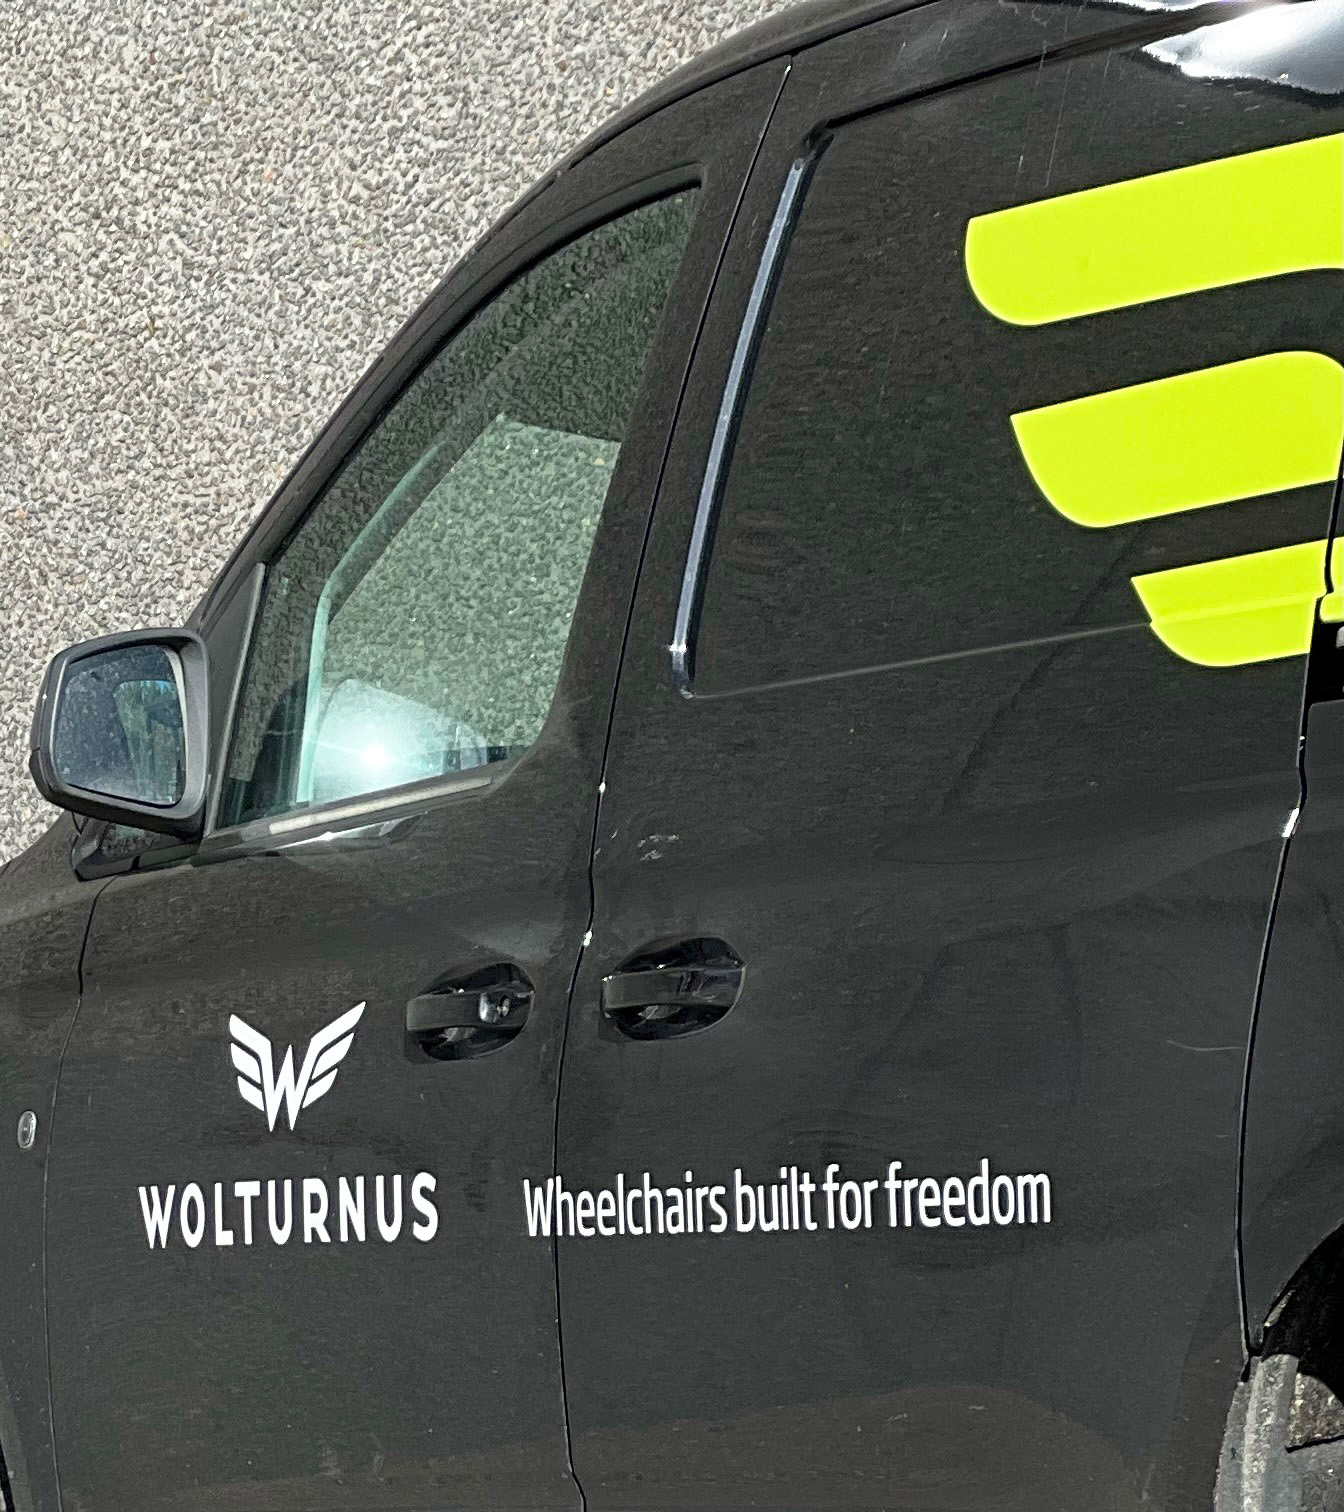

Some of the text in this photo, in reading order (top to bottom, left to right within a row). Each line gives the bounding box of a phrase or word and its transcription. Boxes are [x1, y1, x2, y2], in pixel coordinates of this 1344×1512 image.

[137, 1172, 439, 1249] WOLTURNUS
[523, 1157, 1051, 1237] Wheelchairs built for freedom
